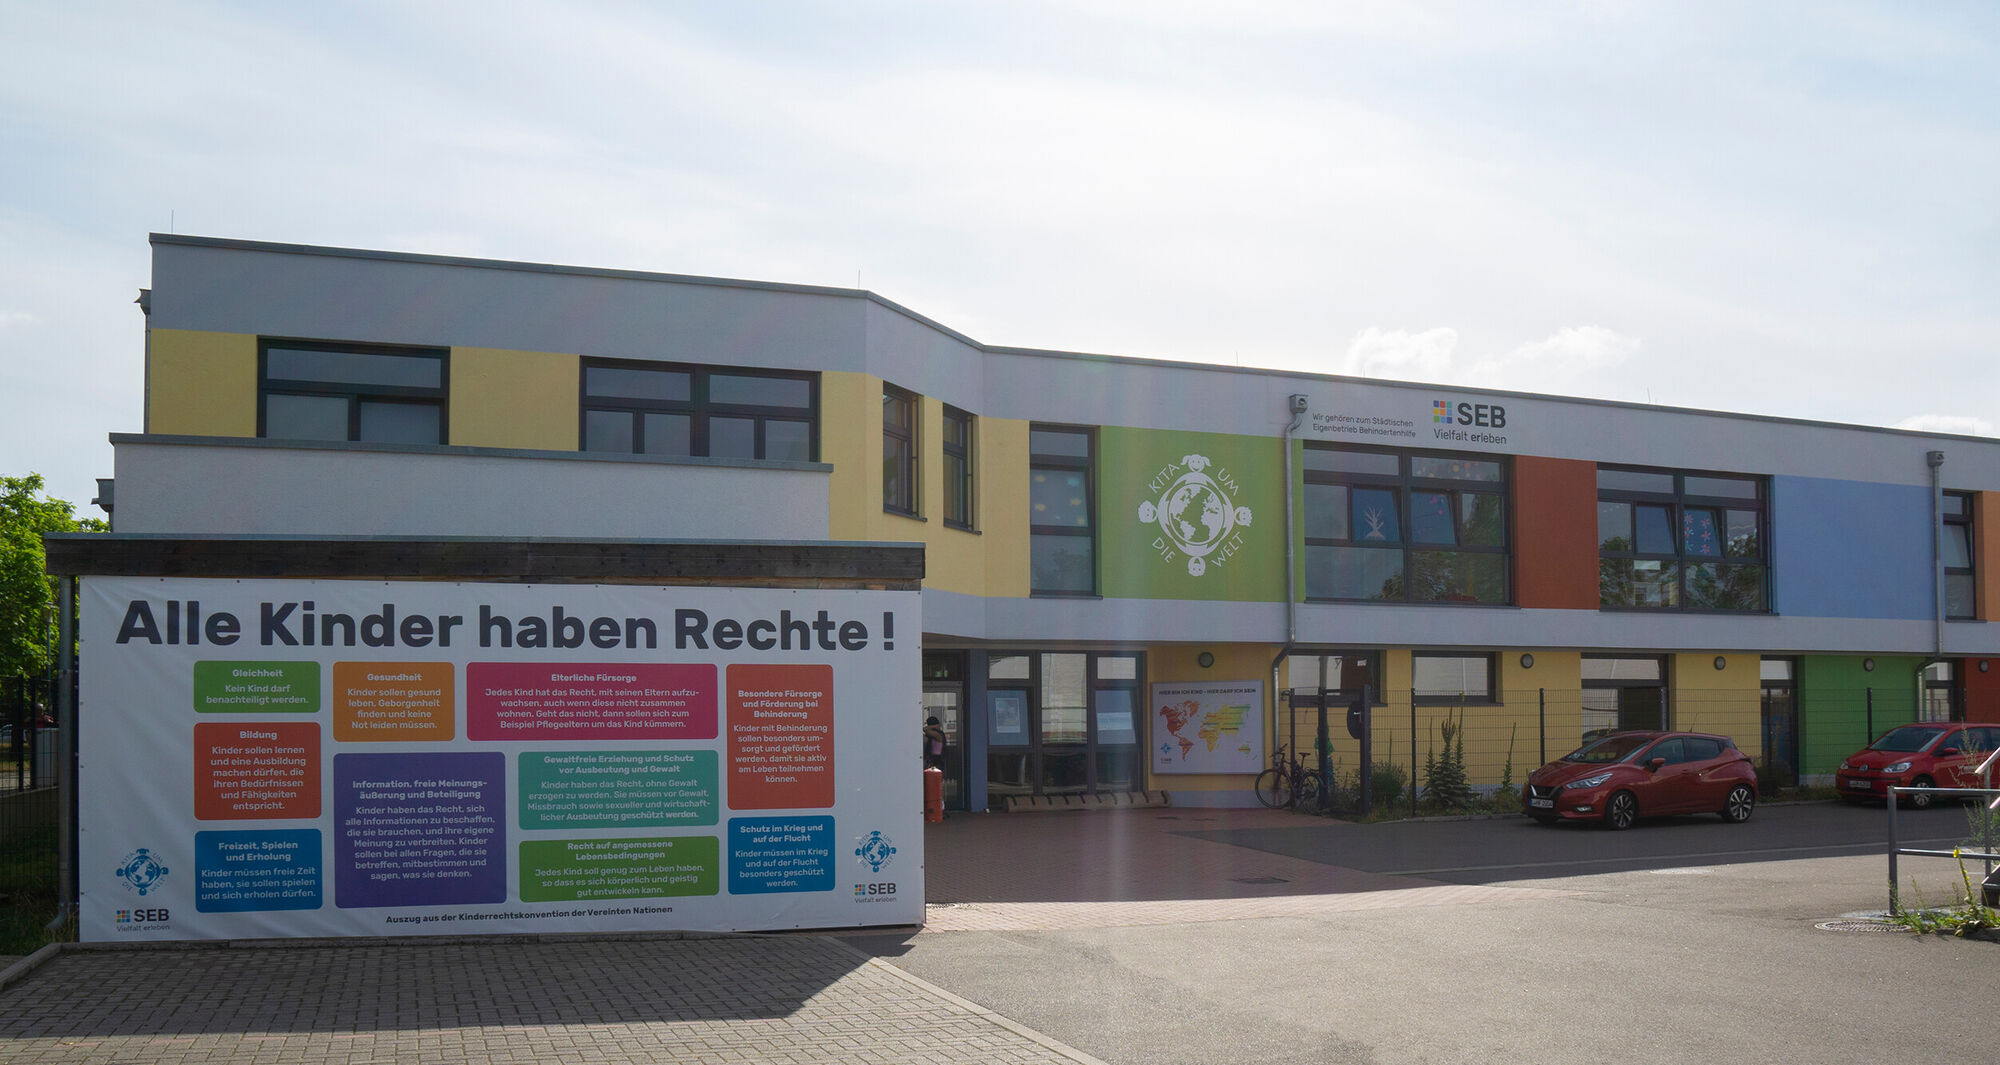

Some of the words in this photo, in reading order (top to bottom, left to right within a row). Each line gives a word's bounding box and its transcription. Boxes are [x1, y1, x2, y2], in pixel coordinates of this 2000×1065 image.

[1312, 413, 1324, 421] Wir
[1325, 414, 1355, 423] gehören
[1371, 417, 1414, 428] Städtischen
[1457, 402, 1506, 429] SEB
[1313, 423, 1358, 434] Eigenbetrieb
[1359, 426, 1416, 438] Behindertenhilfe
[1433, 428, 1468, 442] Vielfalt
[1470, 433, 1507, 445] erleben
[1148, 464, 1180, 494] KITA
[1217, 468, 1239, 496] UM
[1152, 537, 1176, 563] DIE
[1211, 531, 1243, 567] WELT
[115, 599, 240, 646] Alle
[260, 600, 463, 648] Kinder
[479, 604, 657, 649] haben
[674, 608, 868, 651] Rechte
[883, 611, 893, 650] !
[232, 669, 283, 677] Gleichheit
[551, 673, 595, 681] Elterliche
[596, 673, 637, 683] Fürsorge
[225, 684, 245, 692] Kein
[247, 684, 268, 692] Kind
[270, 684, 290, 692] darf
[347, 688, 377, 696] Kinder
[378, 688, 406, 696] sollen
[407, 688, 441, 697] gesund
[485, 688, 512, 696] Jedes
[535, 688, 550, 696] hat
[551, 688, 567, 696] das
[598, 688, 613, 696] mit
[614, 688, 643, 696] seinen
[644, 688, 670, 696] Eltern
[671, 688, 699, 696] aufzu-
[206, 695, 269, 705] benachteiligt
[270, 695, 308, 703] werden.
[738, 689, 783, 697] Besondere
[784, 689, 822, 701] Fürsorge
[377, 698, 440, 709] Geborgenheit
[616, 698, 639, 706] nicht
[760, 699, 804, 709] Förderung
[805, 699, 818, 707] bei
[357, 709, 386, 718] finden
[496, 709, 534, 717] wohnen.
[535, 709, 557, 717] Geht
[602, 709, 624, 717] dann
[625, 709, 651, 717] sollen
[652, 709, 670, 717] sich
[753, 710, 807, 719] Behinderung
[351, 720, 368, 728] Not
[399, 720, 437, 728] müssen.
[500, 720, 534, 729] Beispiel
[536, 720, 589, 729] Pflegeeltern
[623, 719, 642, 727] Kind
[644, 719, 686, 727] kümmern.
[239, 730, 277, 740] Bildung
[211, 746, 243, 754] Kinder
[244, 746, 273, 754] sollen
[210, 757, 229, 765] und
[230, 757, 251, 765] eine
[252, 756, 306, 766] Ausbildung
[543, 755, 597, 763] Gewaltfreie
[598, 754, 643, 764] Erziehung
[644, 754, 662, 762] und
[663, 754, 694, 762] Schutz
[212, 768, 251, 776] machen
[289, 767, 304, 775] die
[575, 765, 630, 775] Ausbeutung
[649, 764, 680, 772] Gewalt
[213, 779, 238, 787] ihren
[240, 778, 303, 787] Bedürfnissen
[413, 779, 436, 787] freie
[438, 779, 487, 788] Meinungs-
[241, 790, 296, 800] Fähigkeiten
[359, 790, 405, 800] äußerung
[407, 790, 425, 798] und
[426, 789, 481, 800] Beteiligung
[232, 801, 285, 811] entspricht.
[740, 825, 770, 833] Schutz
[783, 824, 806, 833] Krieg
[807, 823, 823, 831] und
[784, 834, 811, 842] Flucht
[261, 841, 298, 850] Spielen
[567, 842, 594, 850] Recht
[595, 841, 611, 849] auf
[611, 841, 673, 850] angemessene
[225, 853, 244, 861] und
[246, 852, 291, 862] Erholung
[575, 850, 665, 861] Lebensbedingungen
[735, 849, 761, 857] Kinder
[762, 848, 795, 858] müssen
[795, 848, 806, 858] im
[807, 847, 828, 859] Krieg
[762, 859, 776, 867] auf
[792, 857, 818, 866] Flucht
[739, 869, 782, 878] besonders
[783, 867, 824, 878] geschützt
[766, 879, 798, 887] werden.
[868, 883, 897, 896] SEB
[133, 909, 170, 923] SEB
[385, 914, 421, 925] Auszug
[440, 913, 457, 921] der
[458, 909, 570, 921] Kinderrechtskonvention
[587, 907, 631, 916] Vereinten
[633, 905, 672, 914] Nationen
